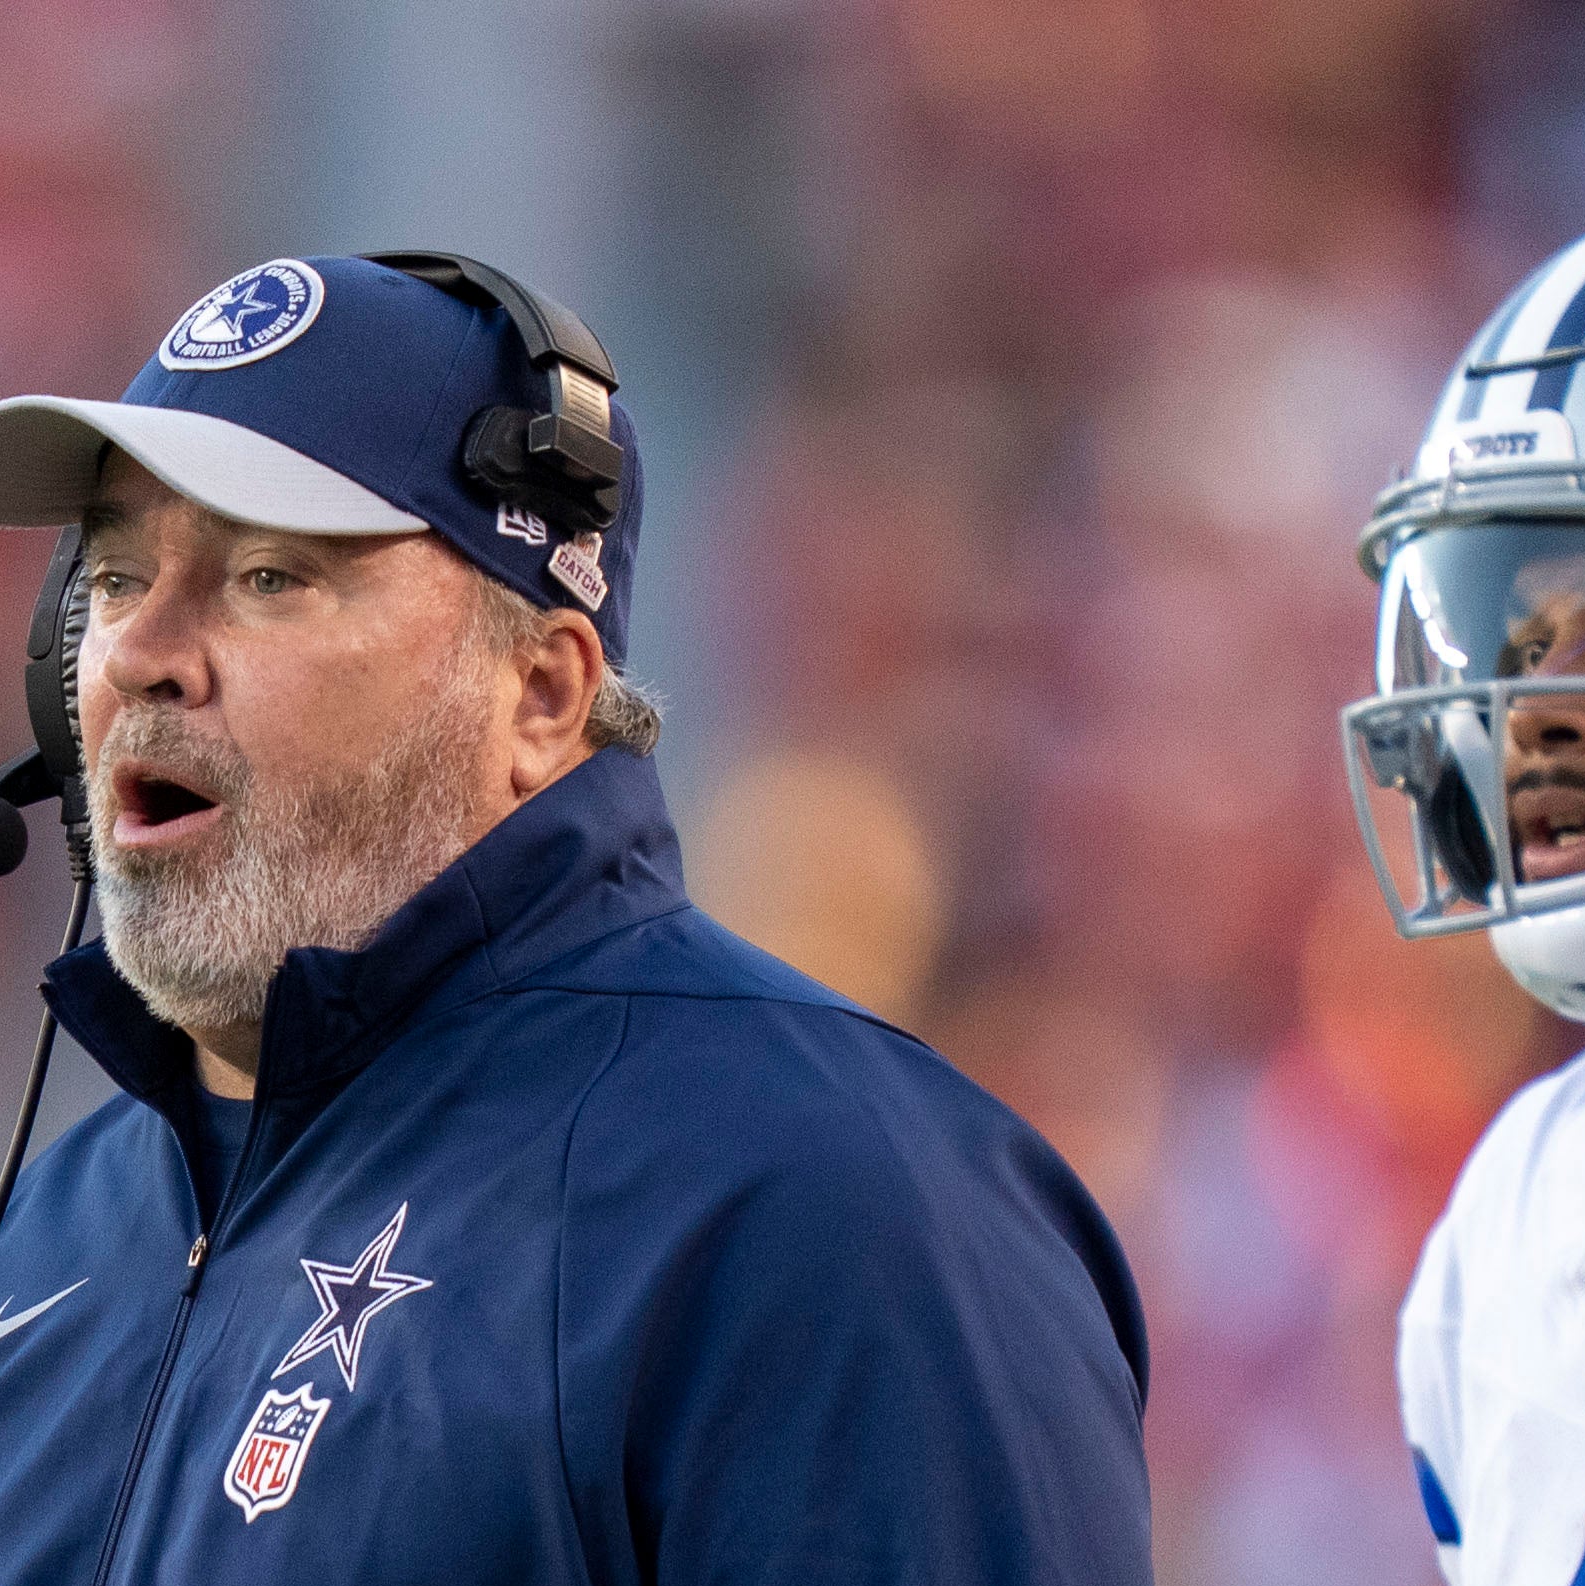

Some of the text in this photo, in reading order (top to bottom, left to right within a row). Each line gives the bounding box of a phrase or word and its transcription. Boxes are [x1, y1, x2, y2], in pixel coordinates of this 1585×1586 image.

[247, 311, 298, 349] LEAGUE
[557, 551, 602, 598] CATCH
[237, 1437, 291, 1495] NFL
